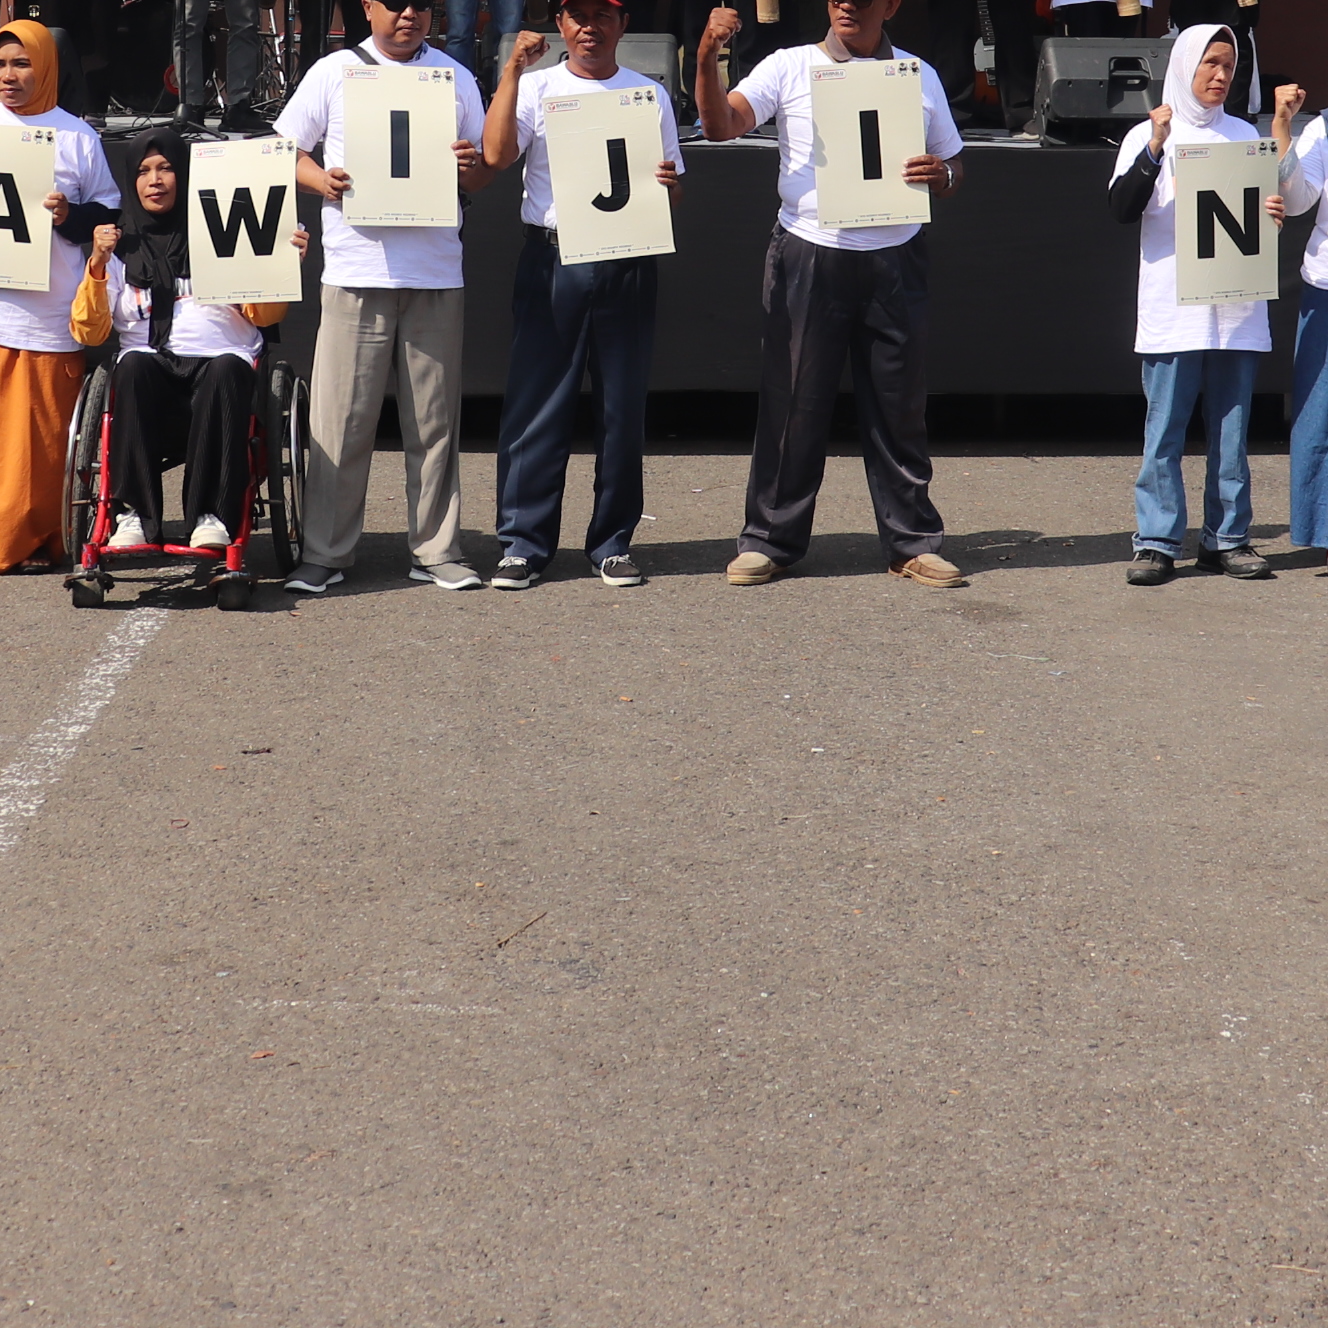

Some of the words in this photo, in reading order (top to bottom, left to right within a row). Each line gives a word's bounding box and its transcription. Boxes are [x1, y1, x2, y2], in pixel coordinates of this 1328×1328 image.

[390, 110, 410, 178] I
[591, 138, 631, 212] J
[859, 110, 882, 180] I
[199, 185, 287, 258] W
[1197, 187, 1260, 259] N
